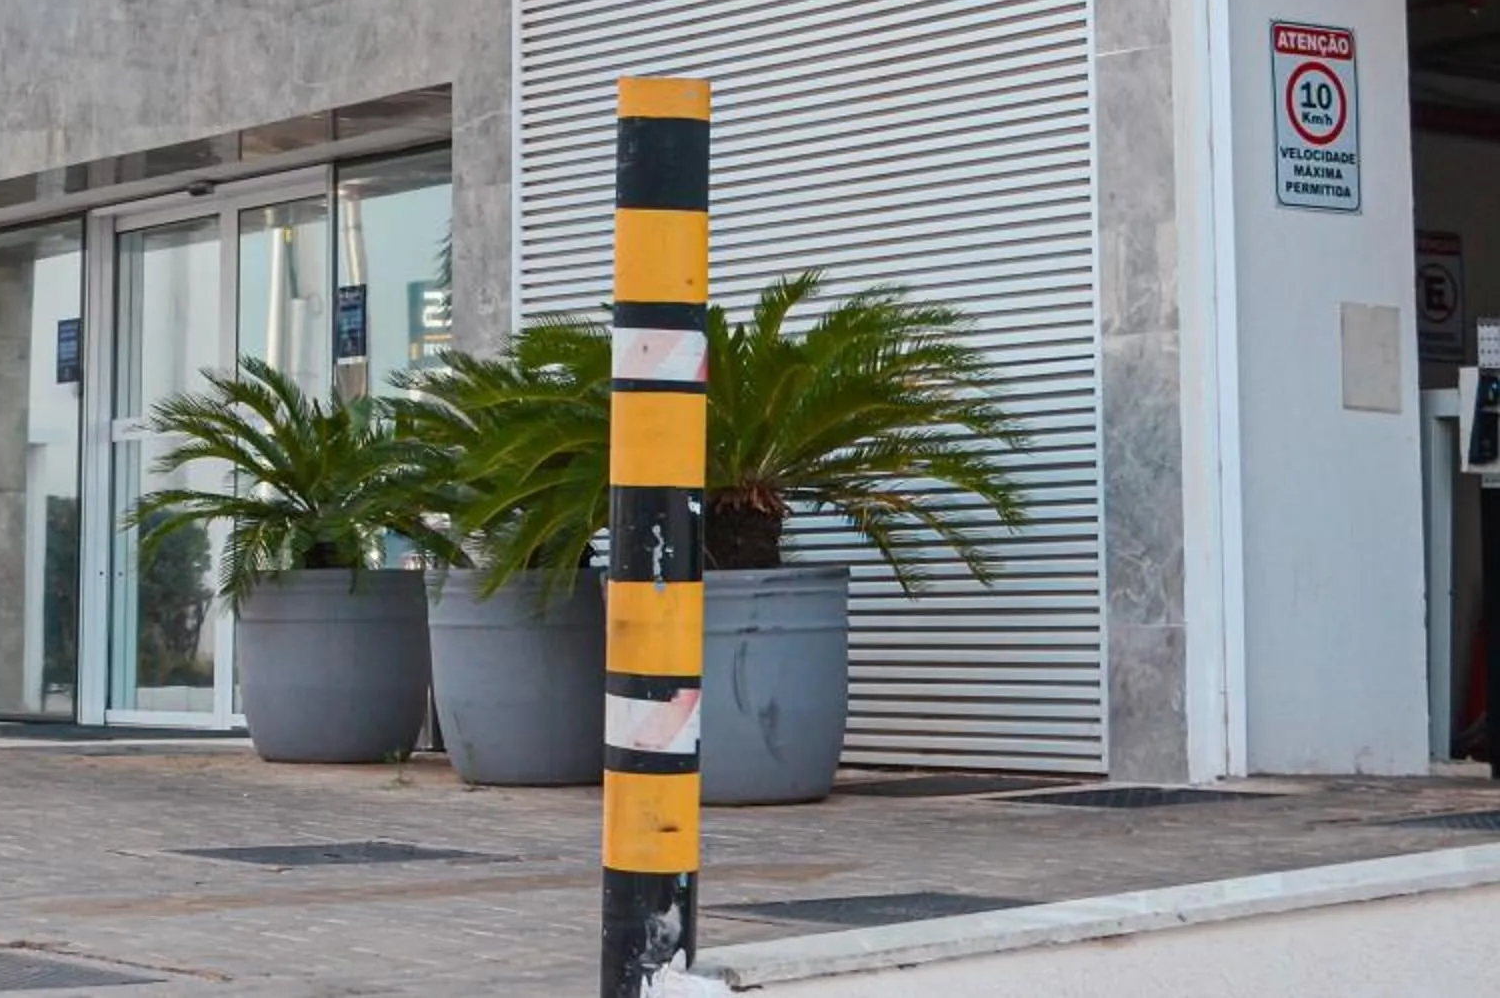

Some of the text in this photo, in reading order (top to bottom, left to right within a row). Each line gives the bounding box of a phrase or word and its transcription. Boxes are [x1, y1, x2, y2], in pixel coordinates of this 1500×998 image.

[1277, 29, 1350, 56] ATENÇÃO
[1300, 81, 1333, 110] 10
[1279, 145, 1357, 165] VELOCIDADE
[1285, 181, 1352, 198] PERMITIDA
